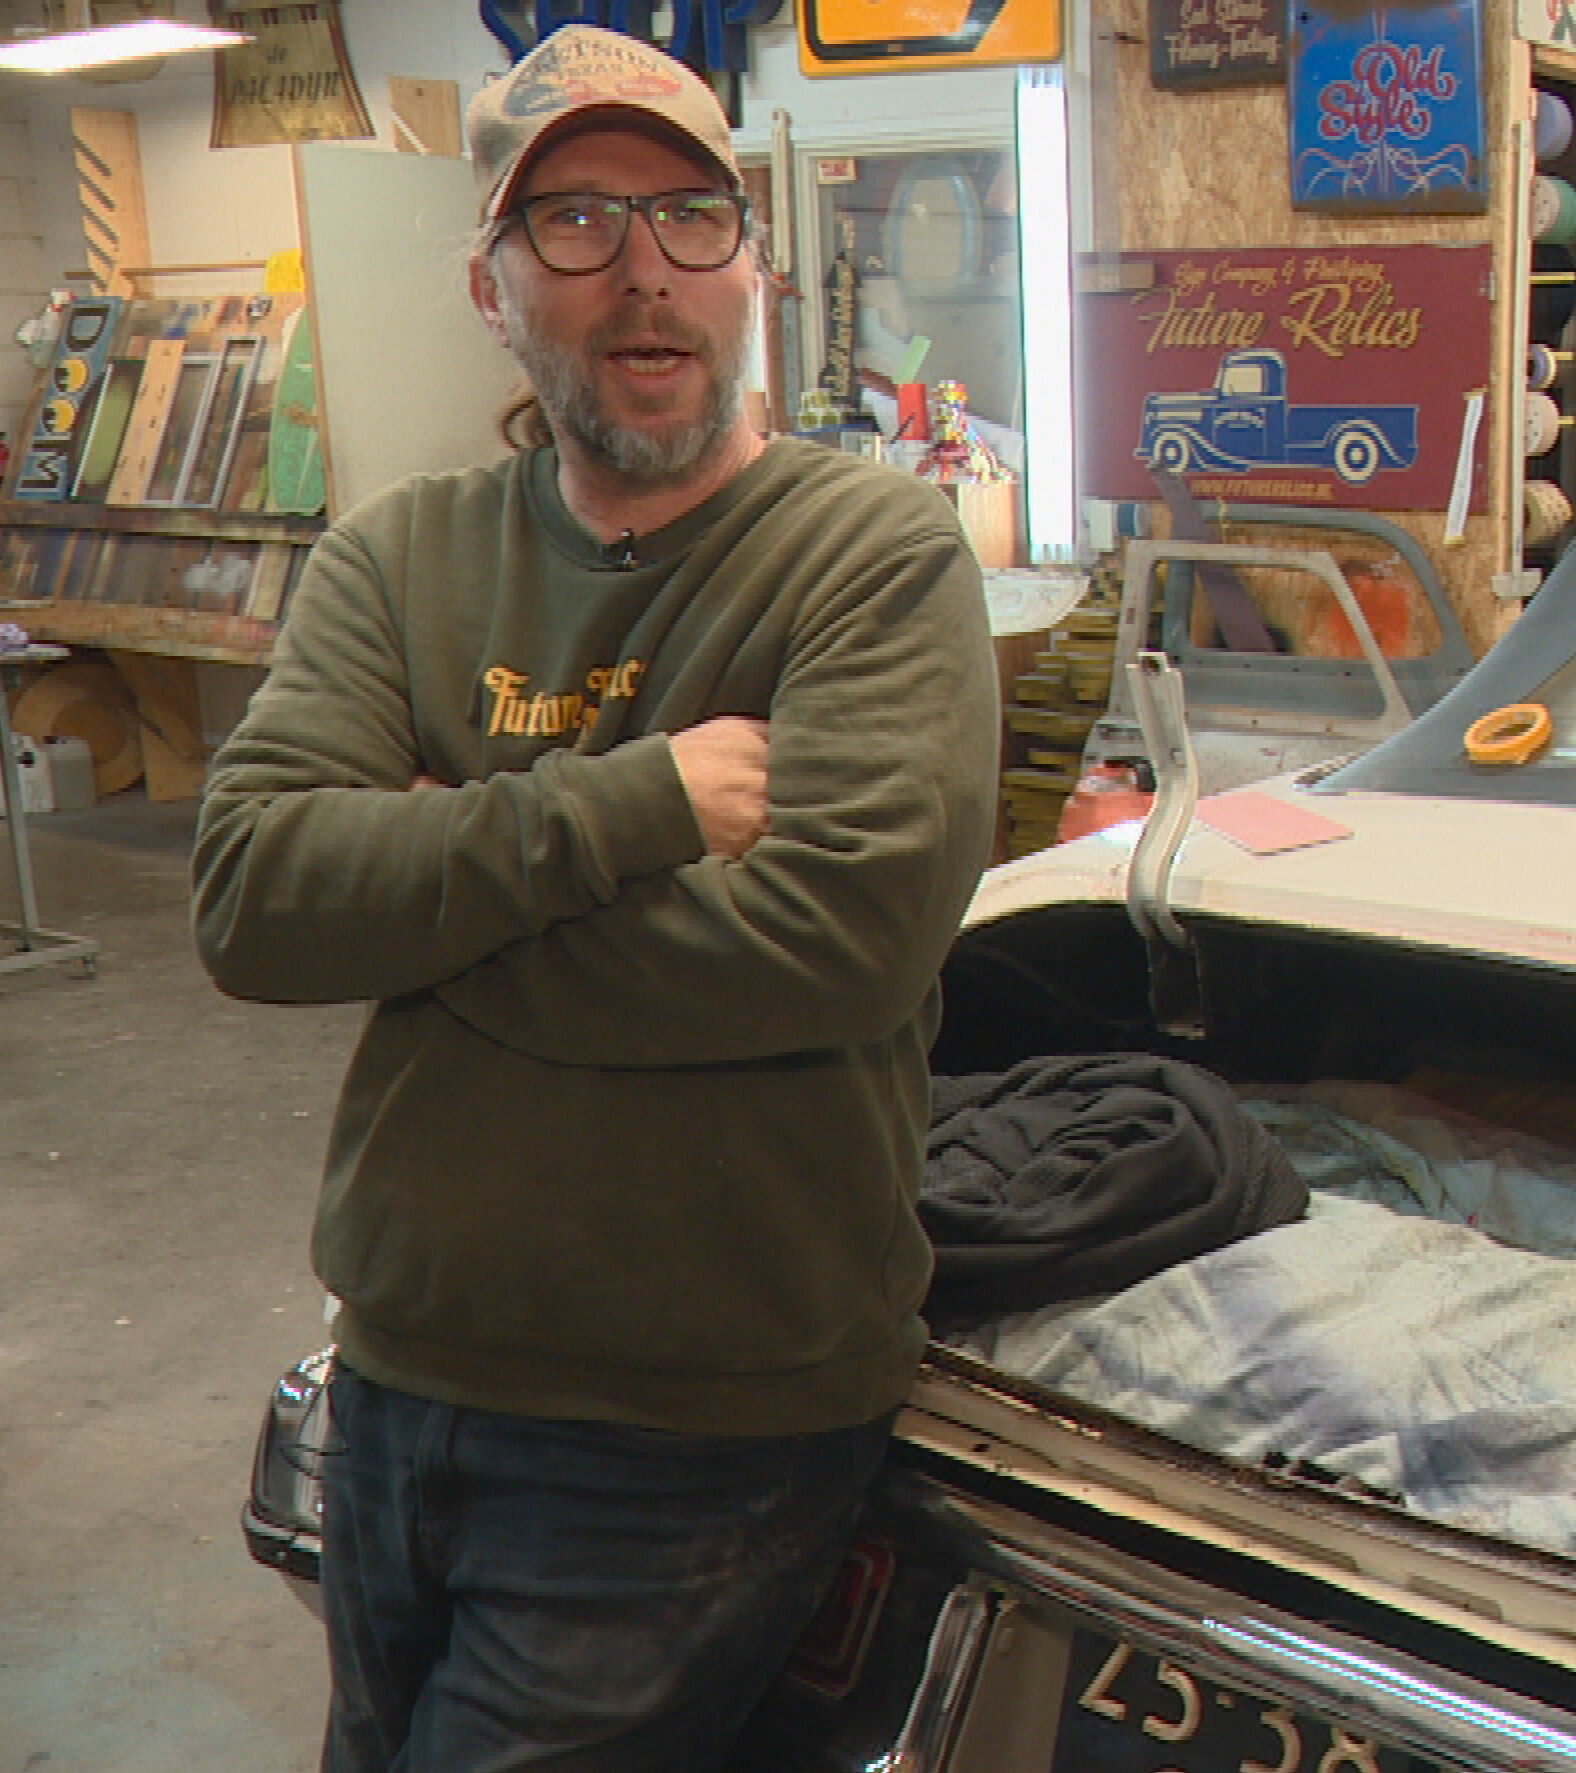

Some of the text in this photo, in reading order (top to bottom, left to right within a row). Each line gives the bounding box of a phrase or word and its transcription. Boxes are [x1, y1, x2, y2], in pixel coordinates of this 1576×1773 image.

[1352, 42, 1461, 101] Old
[1317, 79, 1432, 145] Style
[1131, 284, 1425, 357] Future Relics
